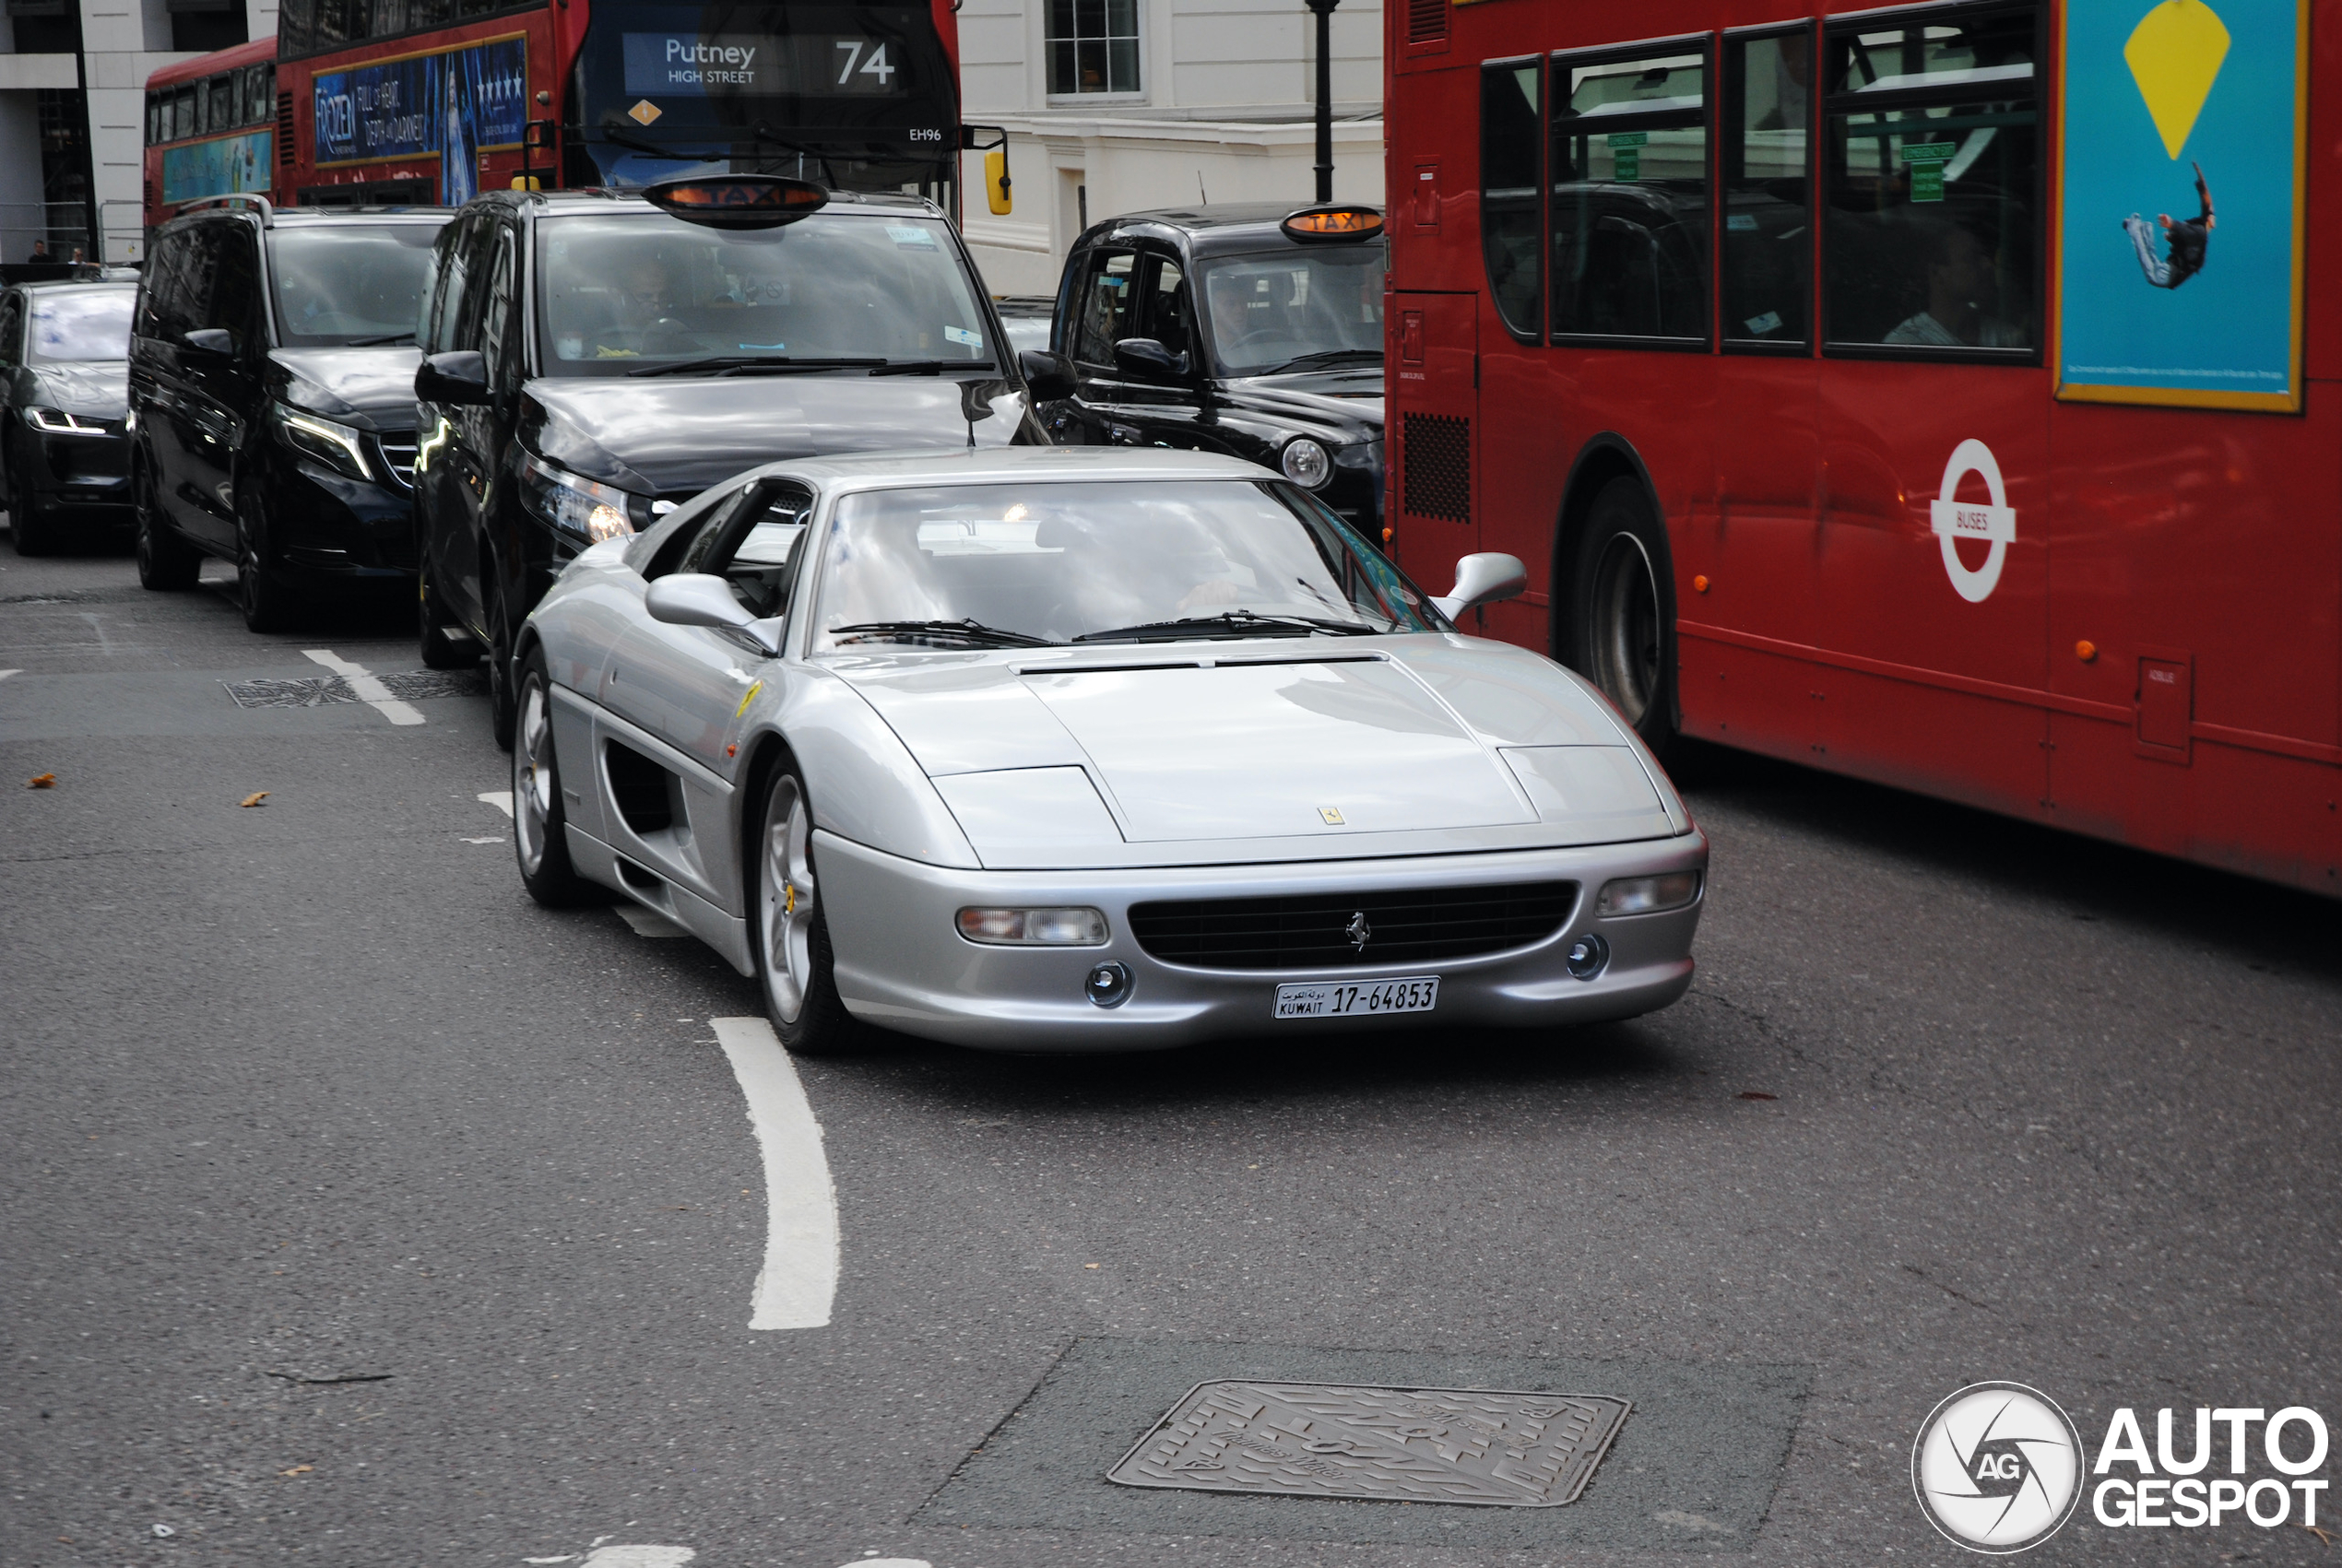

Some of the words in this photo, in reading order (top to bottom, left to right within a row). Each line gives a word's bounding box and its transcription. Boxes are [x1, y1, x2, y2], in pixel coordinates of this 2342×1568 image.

[667, 39, 755, 69] Putney
[836, 41, 895, 85] 74
[668, 70, 704, 83] HIGH
[707, 71, 755, 84] STREET
[315, 87, 357, 154] FROZEN
[909, 129, 941, 141] EH96
[703, 185, 787, 205] TAXI
[1309, 213, 1365, 230] TAXI
[1957, 511, 1988, 531] BUSES
[1331, 982, 1435, 1013] 17-64853
[1279, 1002, 1323, 1015] KUWAIT
[1212, 1429, 1292, 1458] Thames
[1287, 1455, 1354, 1480] Water
